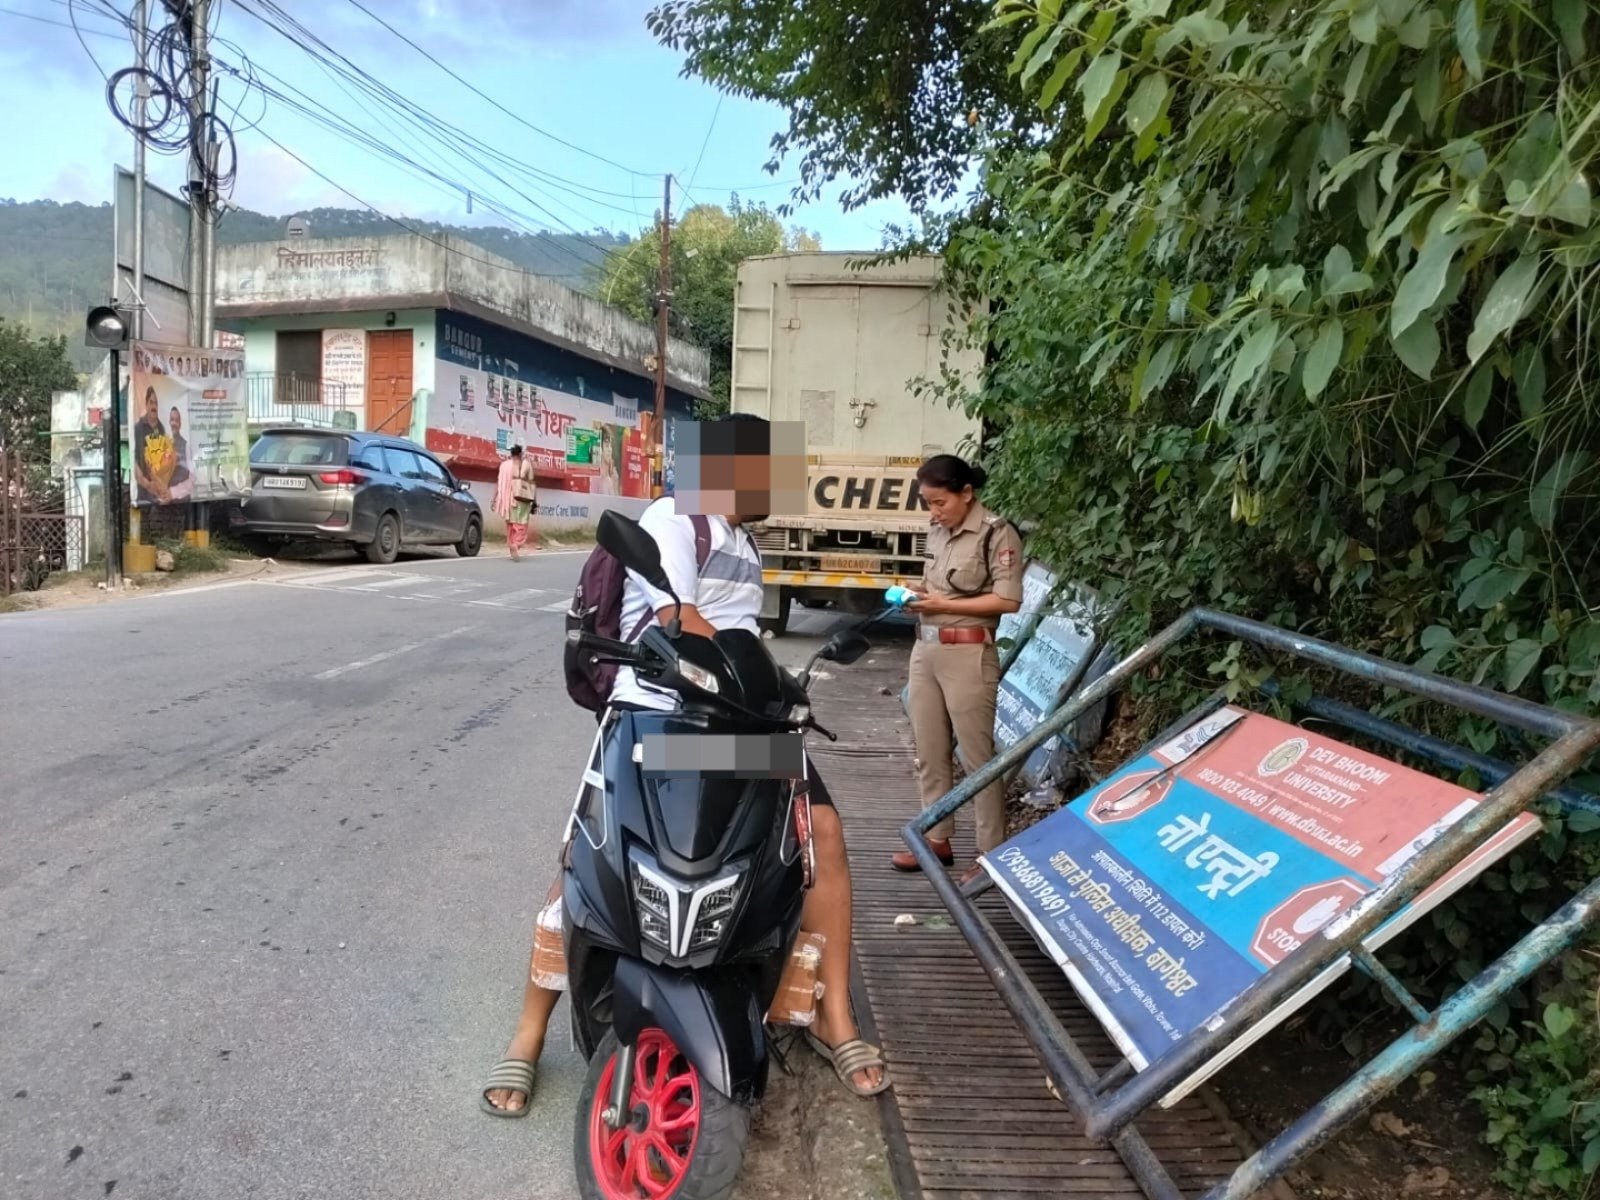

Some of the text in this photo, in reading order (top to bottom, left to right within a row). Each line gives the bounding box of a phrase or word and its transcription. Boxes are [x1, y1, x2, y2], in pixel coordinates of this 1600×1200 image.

[808, 475, 929, 511] CHER
[1304, 764, 1362, 792] UTTARAKHAND
[1308, 746, 1391, 785] DEV BHOOMI
[1196, 767, 1225, 785] 1800
[1218, 778, 1242, 794] 103
[1234, 787, 1268, 807] 4049
[1281, 771, 1357, 809] UNIVERSITY
[1156, 811, 1212, 853] नो
[1046, 850, 1081, 877] आज्ञा
[1065, 868, 1094, 886] से
[1089, 849, 1136, 886] आपातकालीन
[1005, 854, 1071, 918] 9368819491
[1067, 876, 1120, 916] पुलिस
[1124, 878, 1154, 902] स्थिति
[1143, 893, 1162, 907] में
[1148, 902, 1170, 919] 112
[1160, 912, 1190, 936] डायल
[1267, 928, 1301, 952] STOP
[1142, 944, 1202, 999] बागेश्वर
